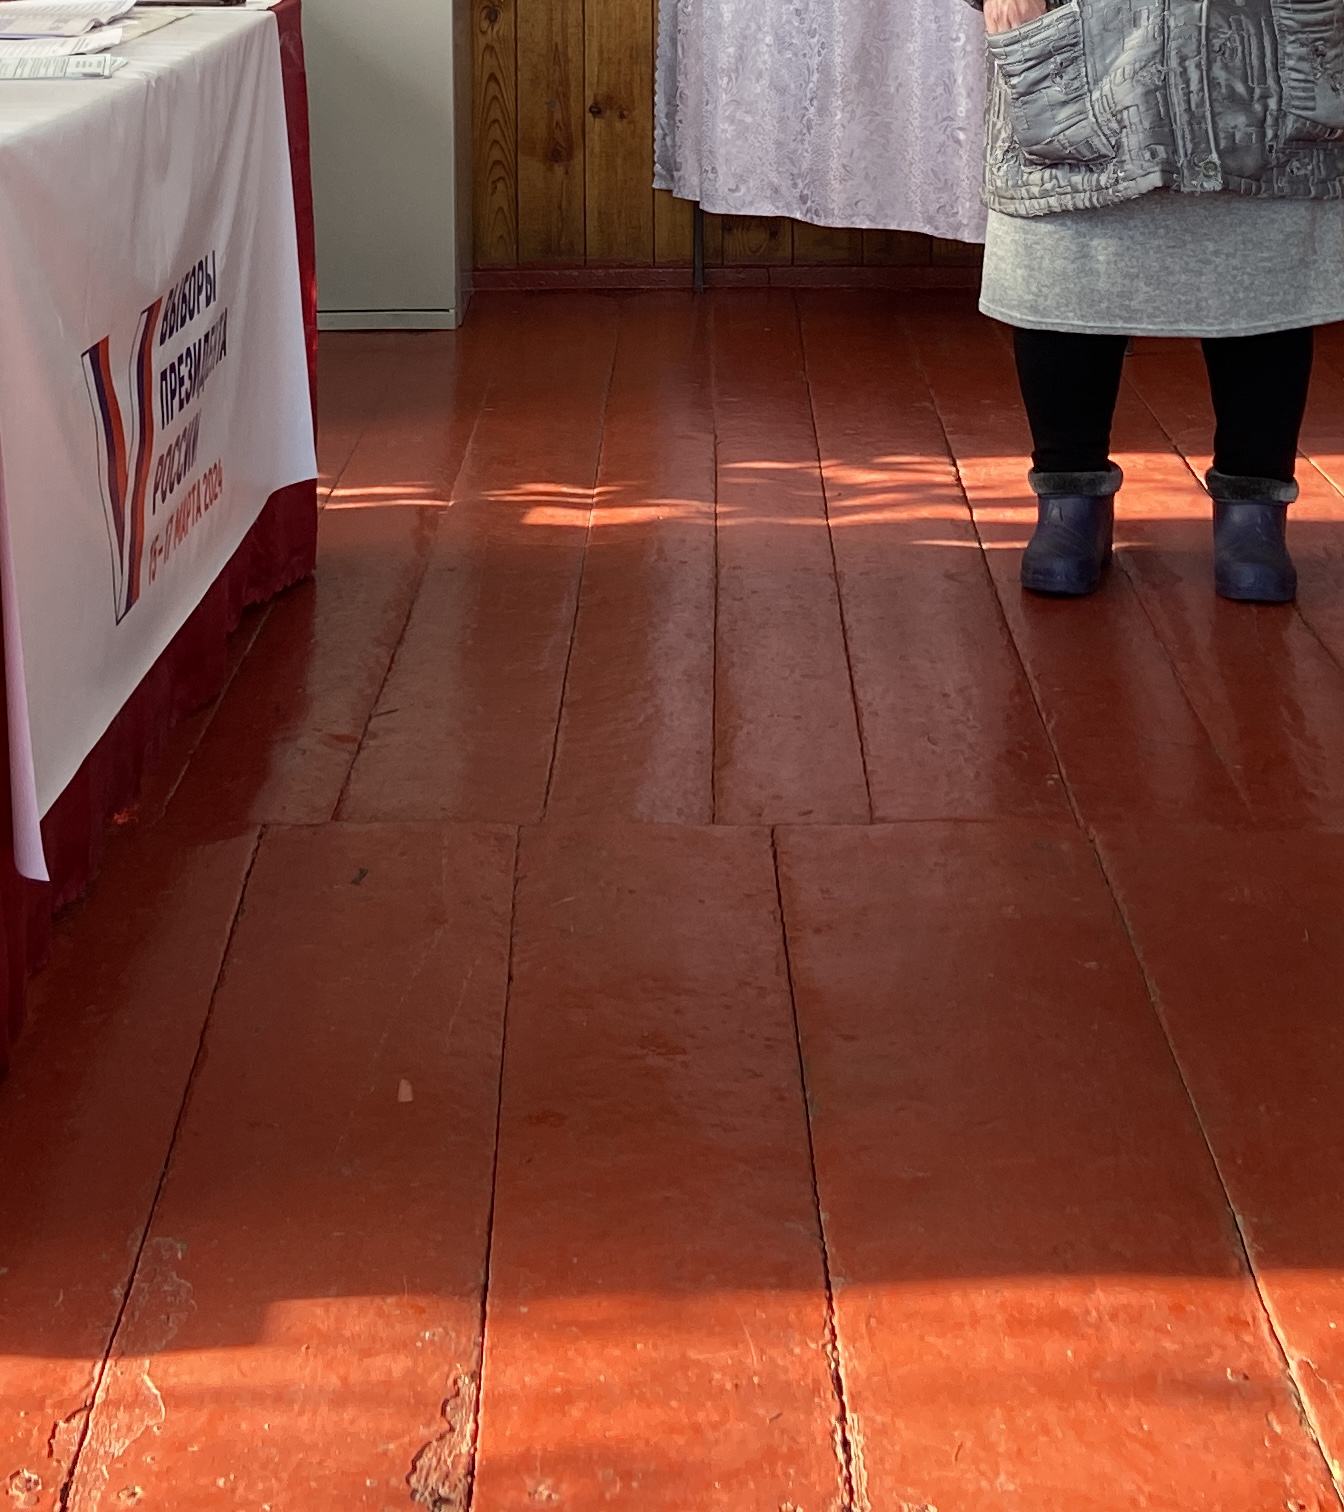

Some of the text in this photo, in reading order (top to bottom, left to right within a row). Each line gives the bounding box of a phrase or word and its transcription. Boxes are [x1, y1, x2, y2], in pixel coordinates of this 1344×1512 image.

[159, 249, 217, 347] ВЫБОРЫ
[151, 408, 203, 516] РОССИИ
[173, 477, 203, 551] МАРТА
[202, 457, 224, 513] 2024
